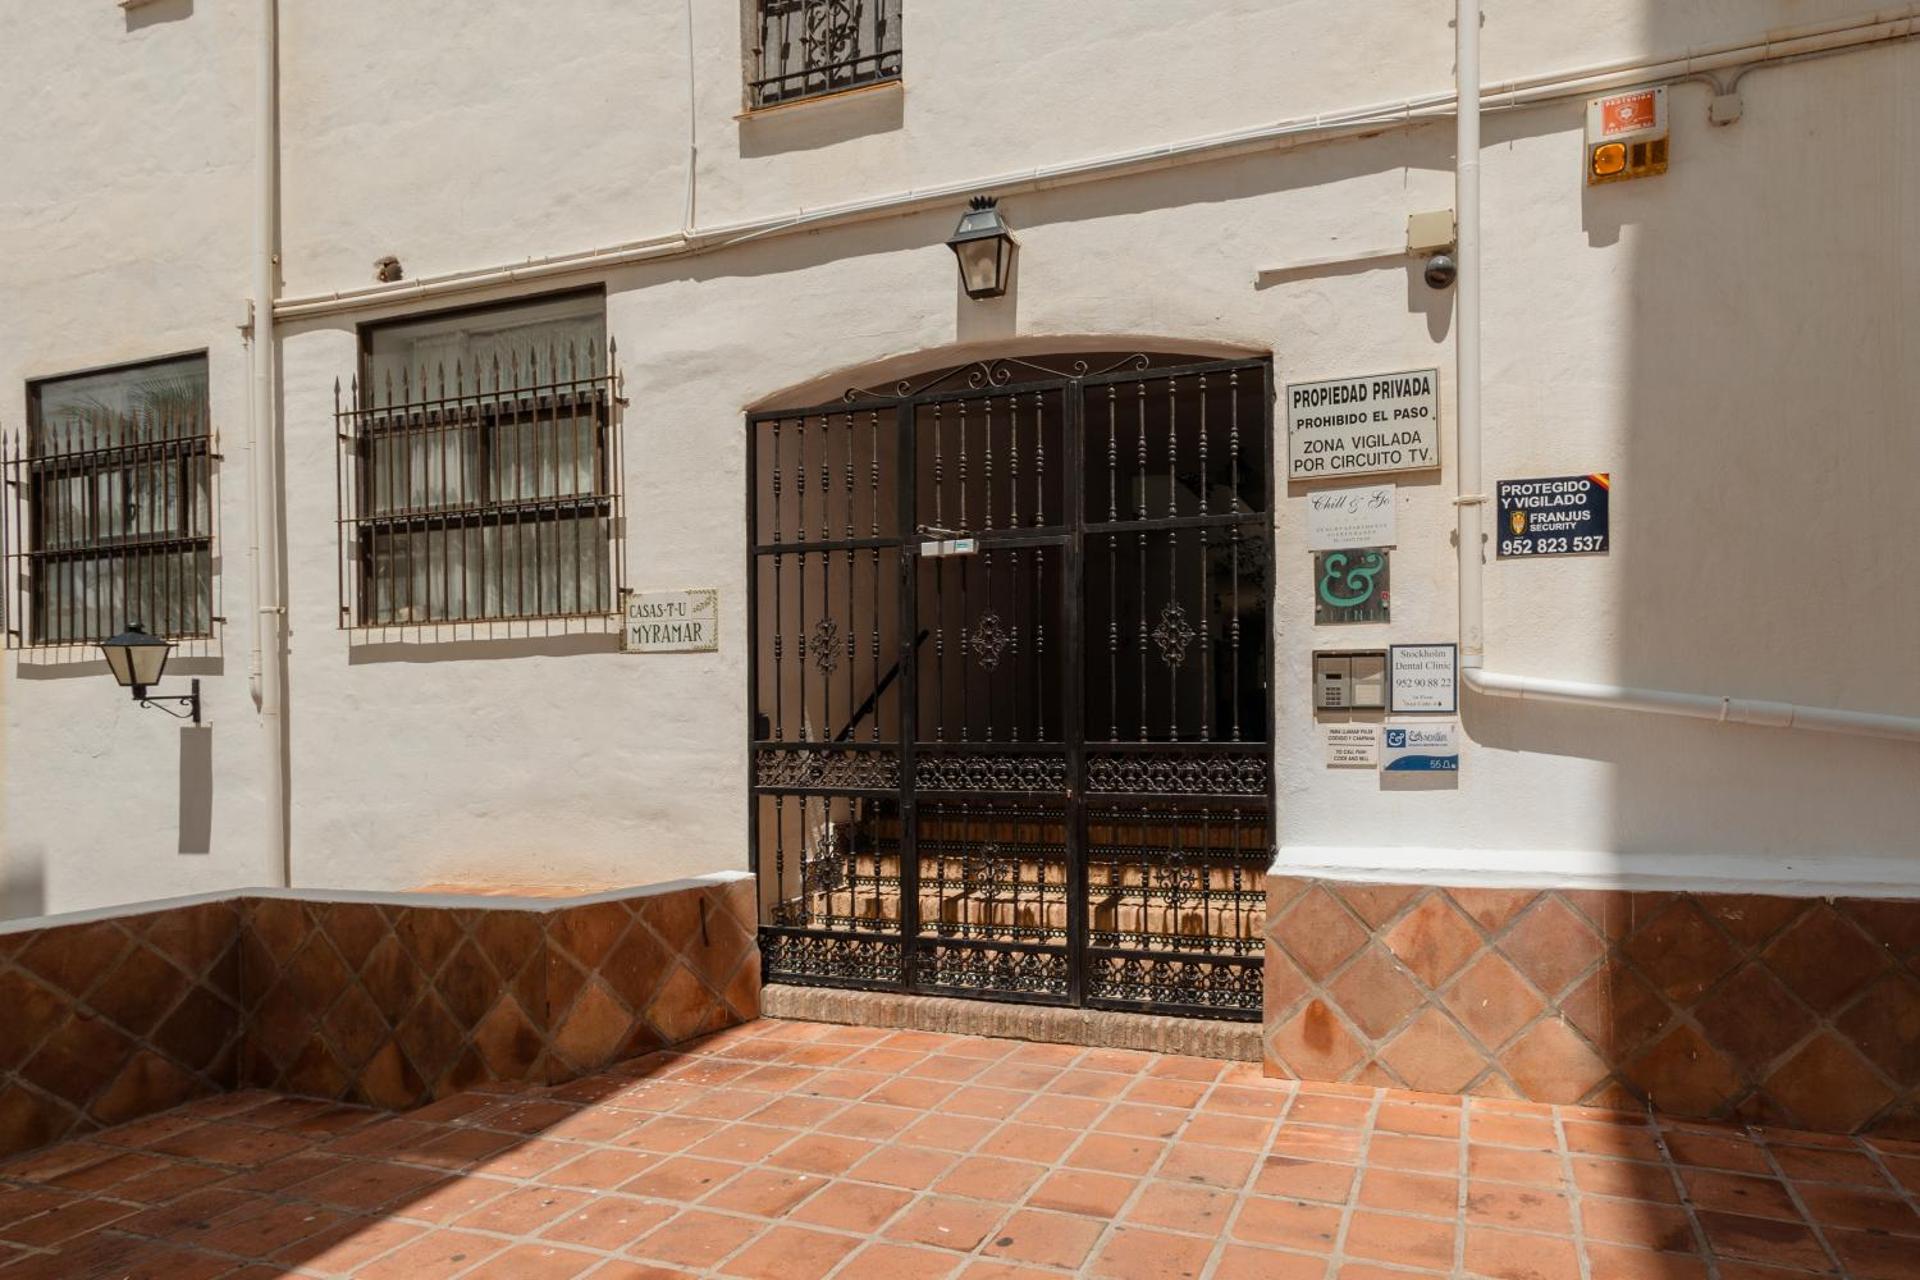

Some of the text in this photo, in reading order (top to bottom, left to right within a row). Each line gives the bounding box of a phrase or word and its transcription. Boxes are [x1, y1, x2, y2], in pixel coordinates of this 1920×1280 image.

[1293, 376, 1431, 409] PROPIEDAD PRIVADA
[1296, 406, 1428, 430] PROHIBIDO EL PASO
[1303, 431, 1422, 454] ZONA VIGILADA
[1294, 457, 1324, 472] POR
[1330, 450, 1402, 469] CIRCUITO
[1501, 480, 1591, 496] PROTEGIDO
[1311, 494, 1348, 511] Chill
[1501, 493, 1587, 509] Y VIGILADO
[1530, 510, 1591, 523] FRANJUS
[1530, 521, 1577, 532] SECURITY
[1502, 535, 1604, 555] 952 823 537
[632, 622, 703, 644] MYRAMAR
[1400, 649, 1446, 658] Stockholm
[1395, 661, 1451, 670] Dental Clinic
[1395, 677, 1452, 688] 952 90 88 22
